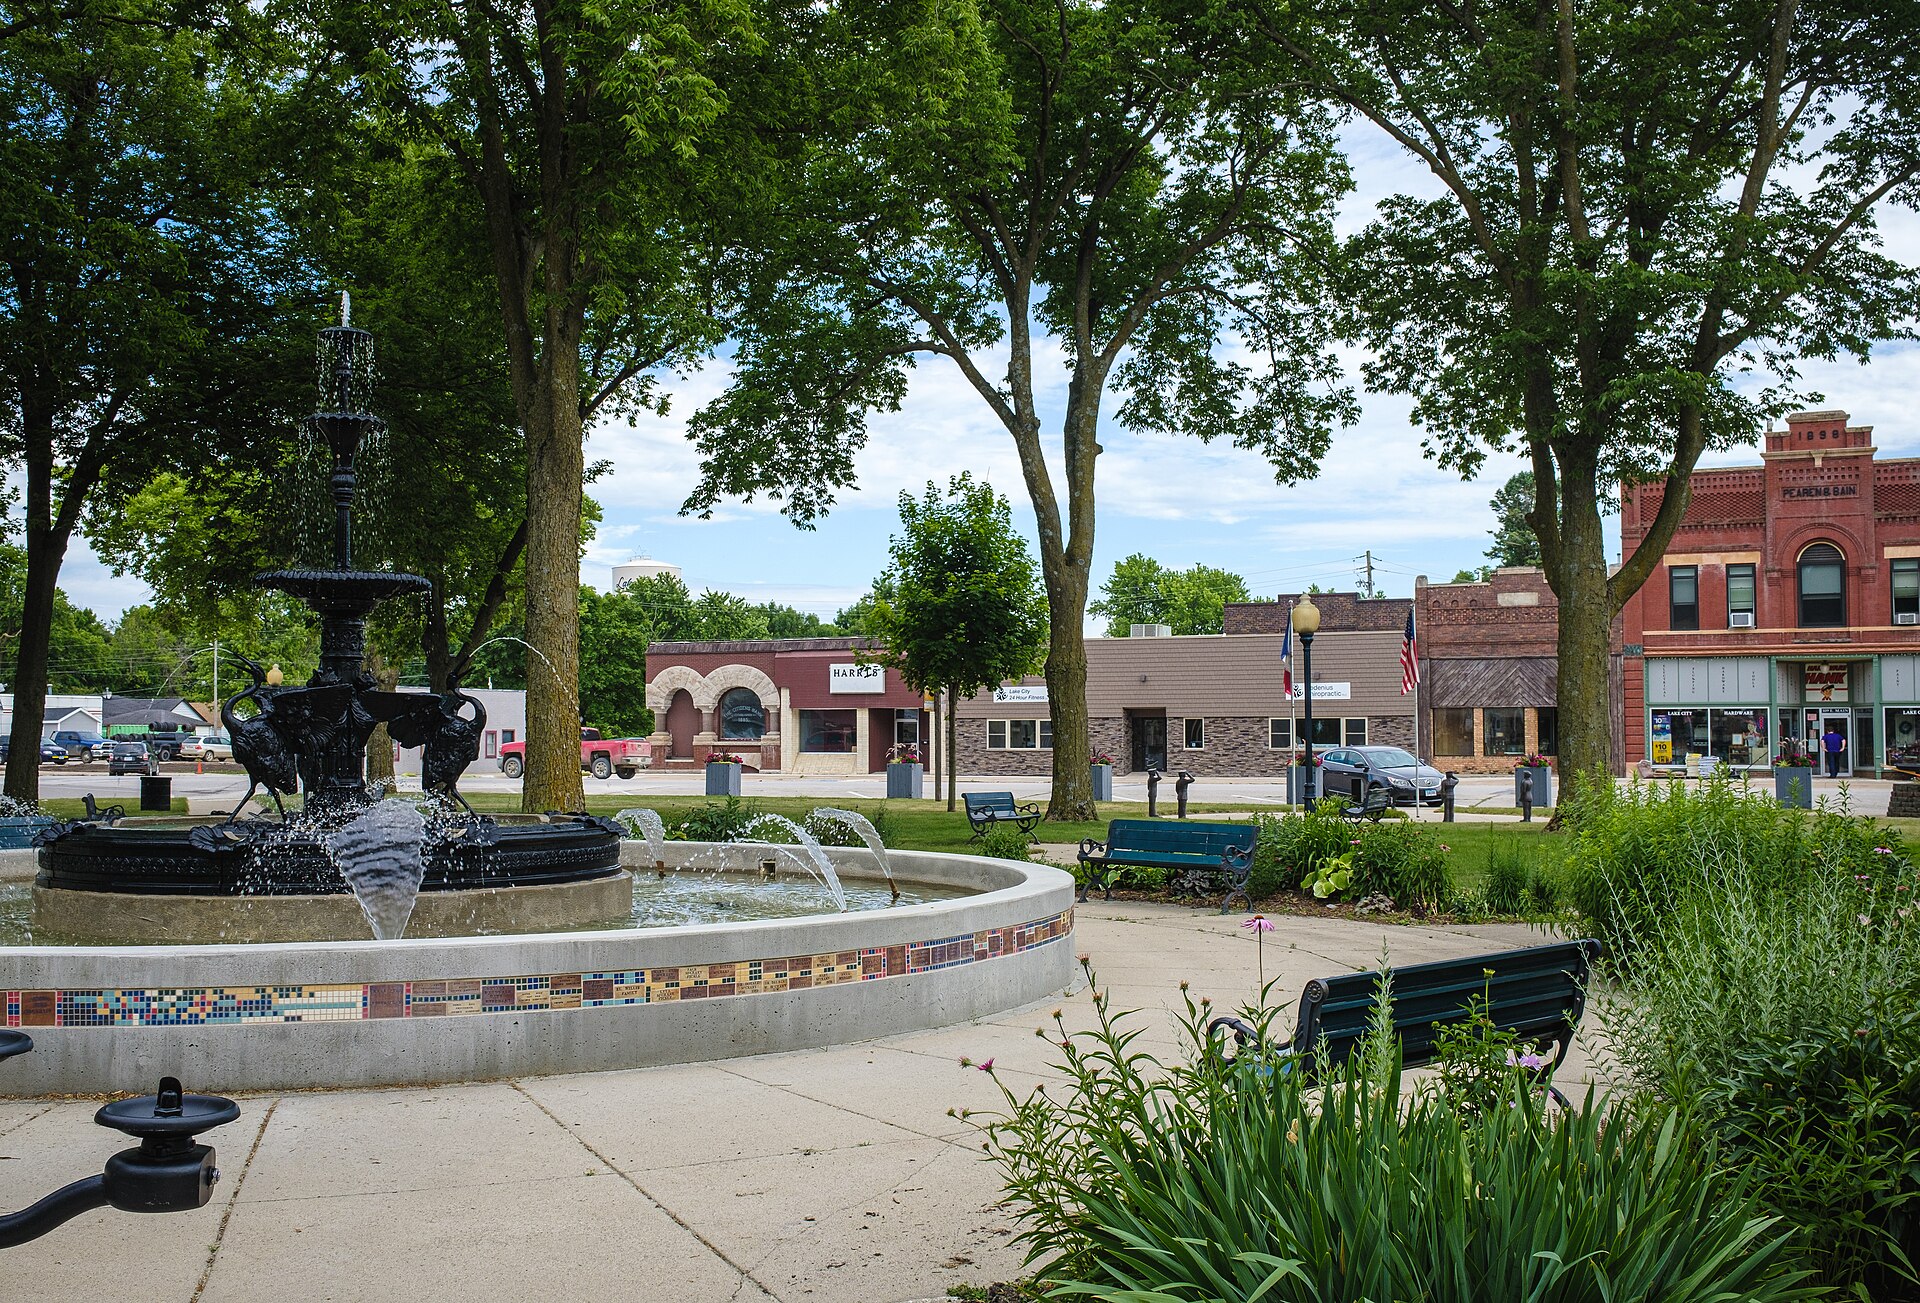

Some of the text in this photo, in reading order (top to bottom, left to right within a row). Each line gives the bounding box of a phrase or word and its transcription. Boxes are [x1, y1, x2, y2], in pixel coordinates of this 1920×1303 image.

[1798, 430, 1839, 440] 1898
[1783, 485, 1856, 499] PEAREN & BAIN
[1805, 672, 1847, 684] HANK
